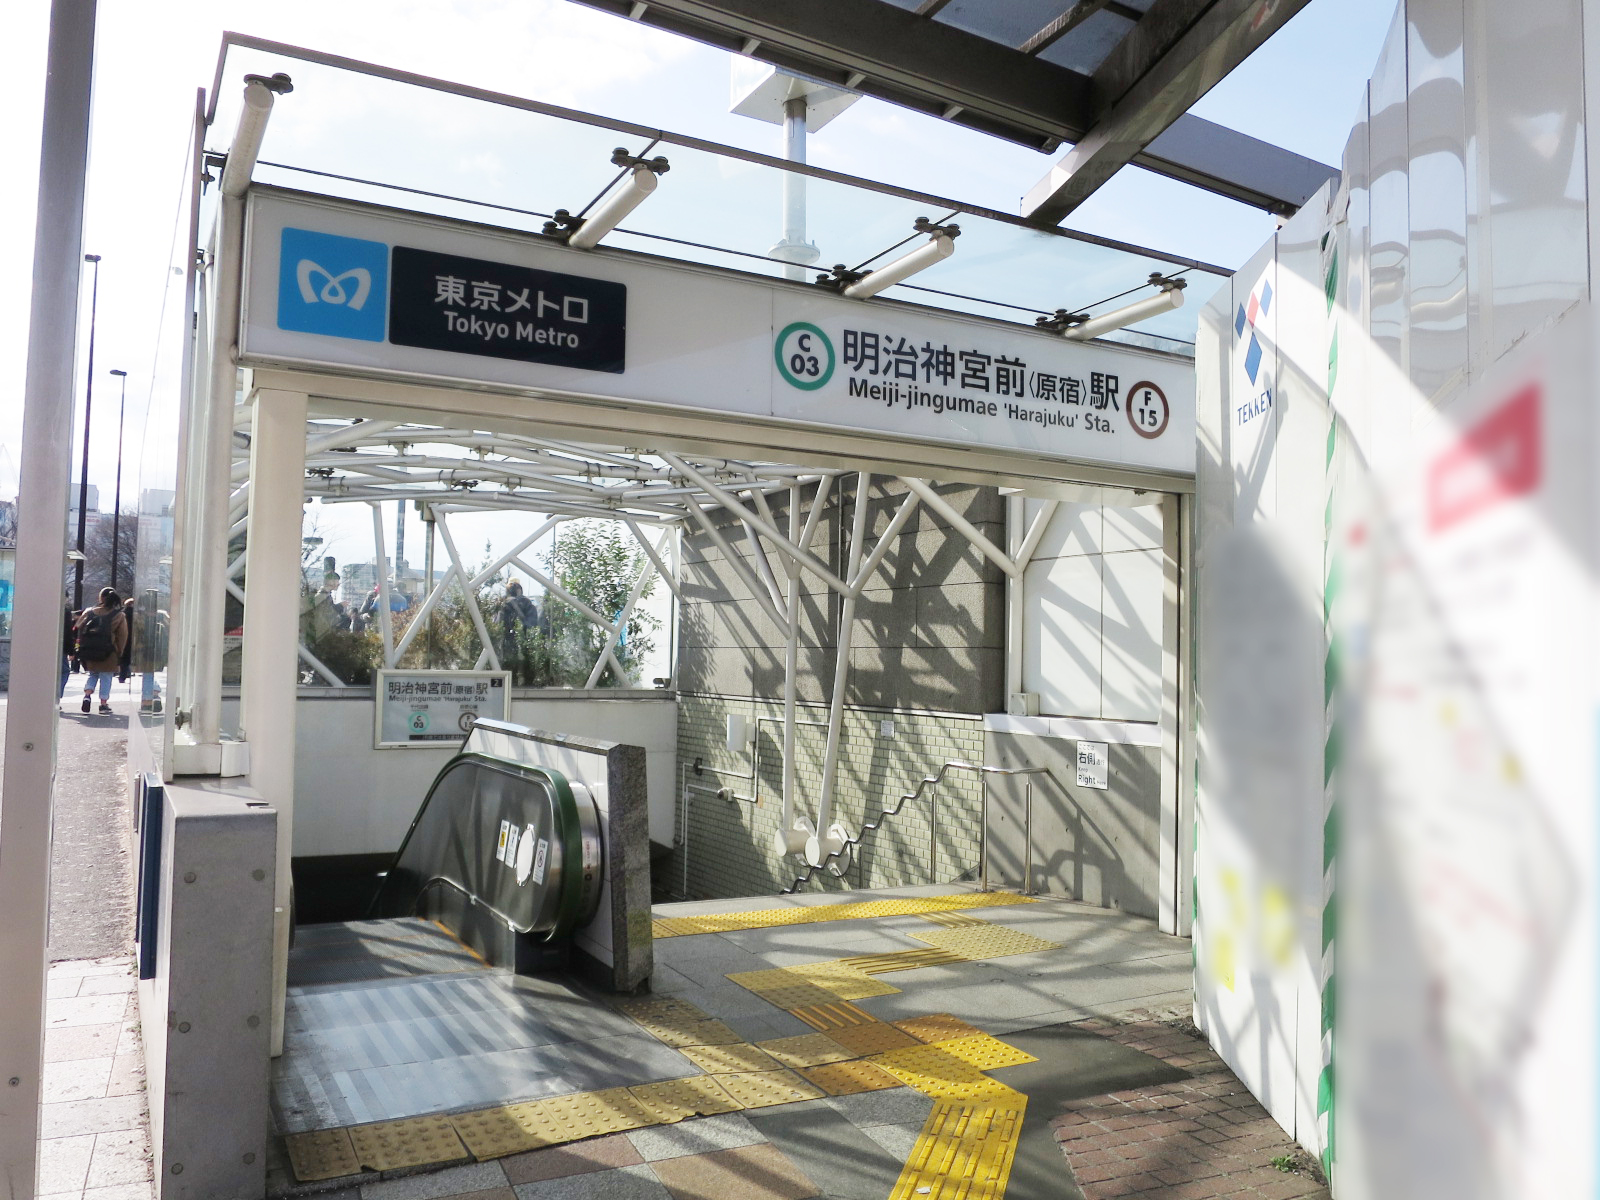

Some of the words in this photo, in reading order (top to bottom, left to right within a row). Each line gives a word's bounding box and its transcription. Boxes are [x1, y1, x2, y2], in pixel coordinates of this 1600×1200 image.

[434, 275, 589, 324] 東京メトロ
[443, 311, 510, 341] Tokyo
[515, 321, 579, 349] Metro
[797, 333, 811, 353] C
[790, 354, 820, 377] 03
[848, 377, 998, 417] Meiji-jingumae
[1003, 403, 1079, 429] 'Harajuku'
[1084, 413, 1115, 434] Sta.
[1143, 390, 1152, 406] F
[1237, 388, 1272, 426] TEKKEN
[1138, 408, 1158, 428] 15
[388, 695, 442, 704] Meiji-jingumae
[1079, 775, 1096, 785] Right
